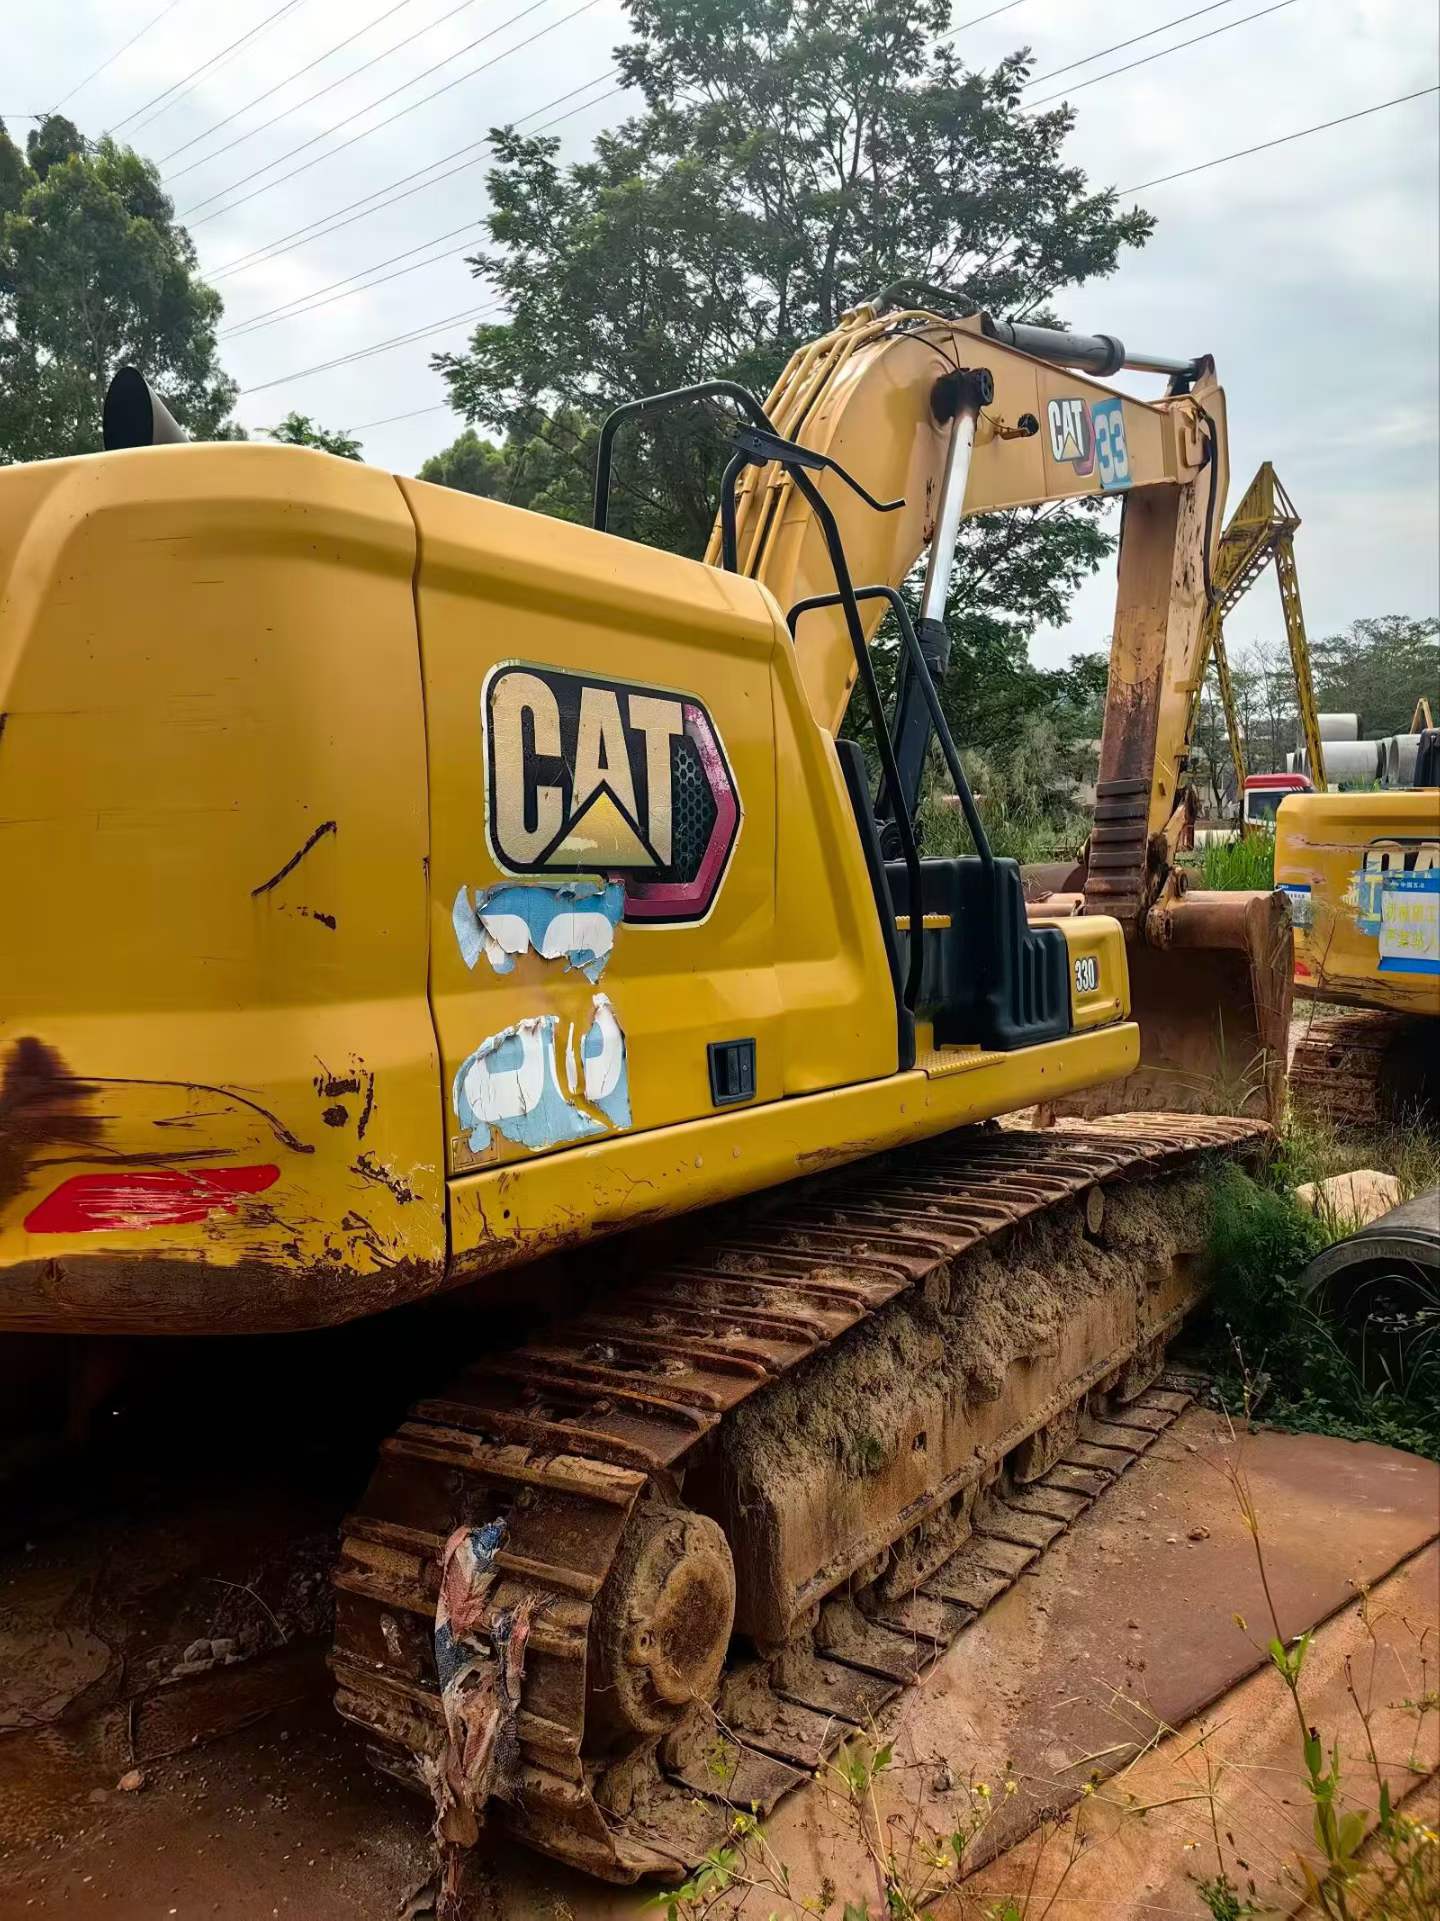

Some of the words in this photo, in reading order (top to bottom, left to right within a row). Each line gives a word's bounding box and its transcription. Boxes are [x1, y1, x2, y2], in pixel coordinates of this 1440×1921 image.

[1047, 400, 1085, 460] CAT
[1094, 410, 1128, 483] 33
[489, 672, 684, 866] CAT
[1074, 957, 1095, 992] 330
